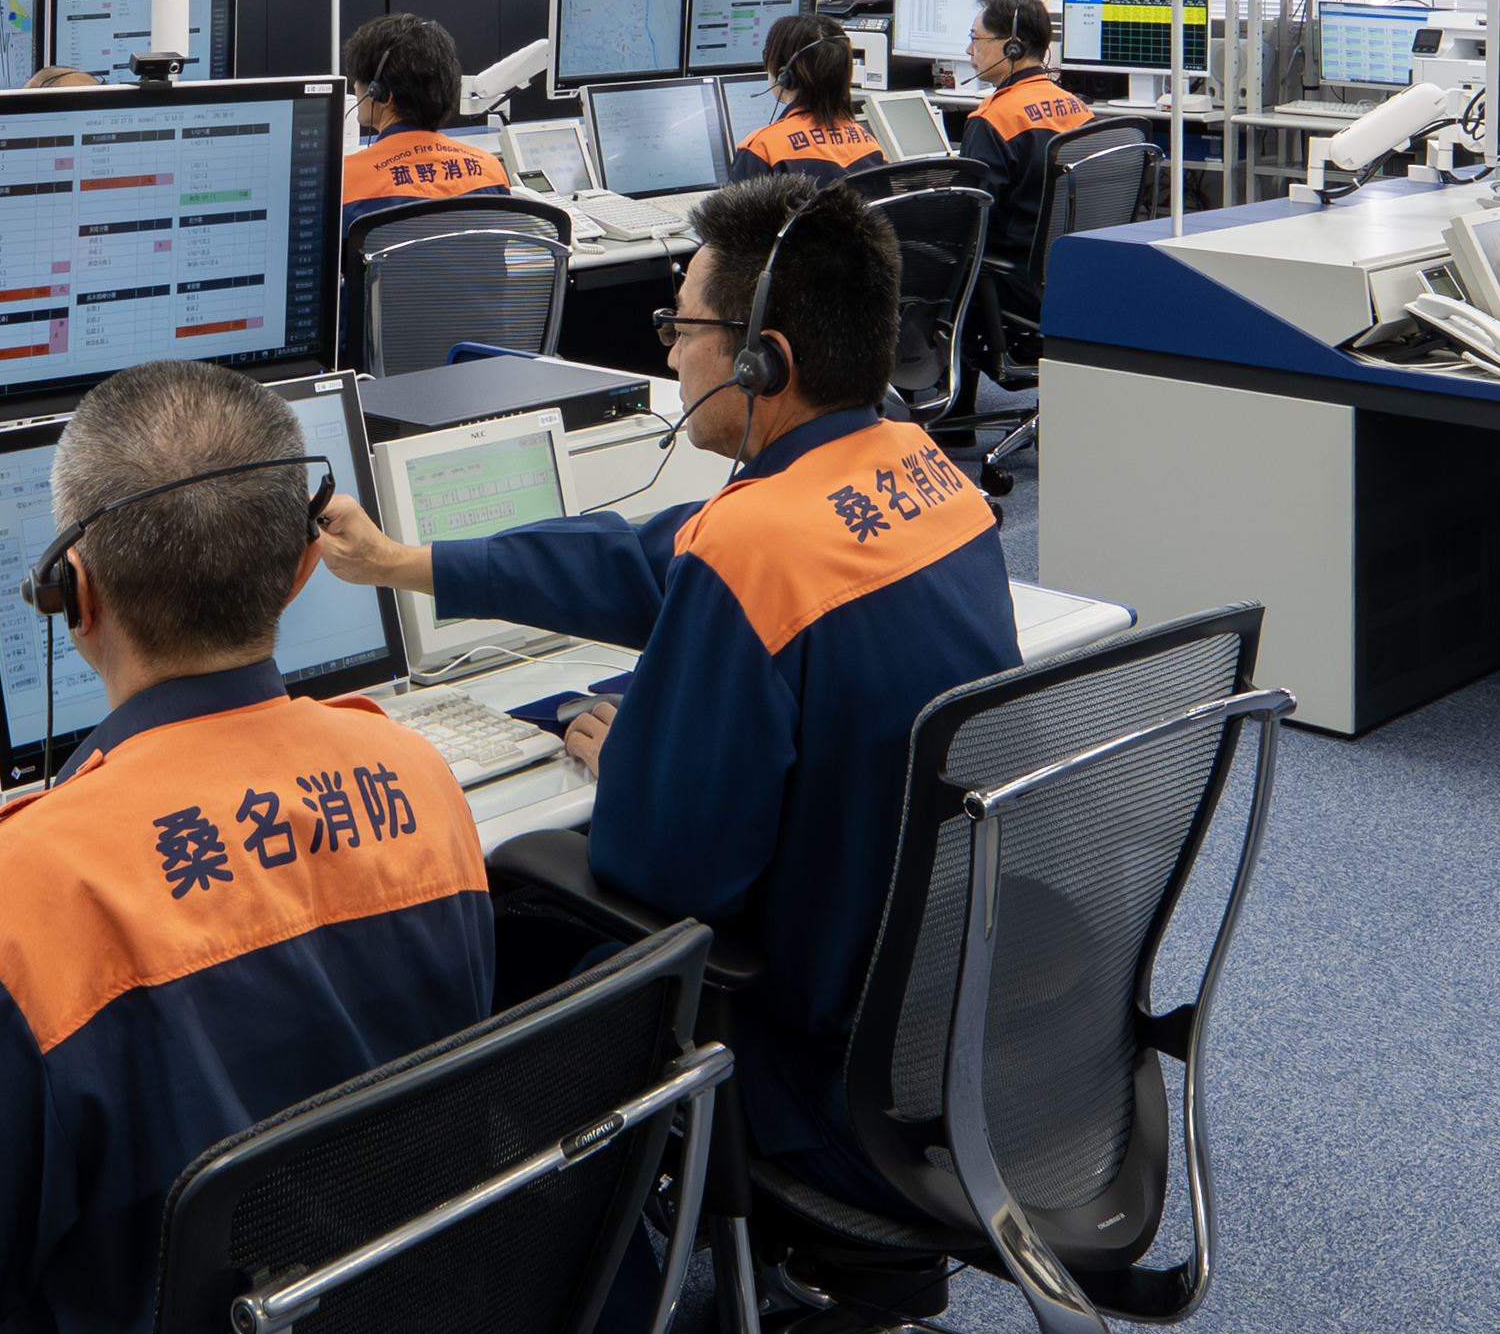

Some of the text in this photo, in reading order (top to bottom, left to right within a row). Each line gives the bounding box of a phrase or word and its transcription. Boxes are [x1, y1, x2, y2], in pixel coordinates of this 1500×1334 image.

[374, 143, 484, 171] Komono Fire Department
[389, 157, 483, 186] 菰野消防
[827, 445, 963, 543] 桑名消防
[153, 762, 417, 899] 桑名消防
